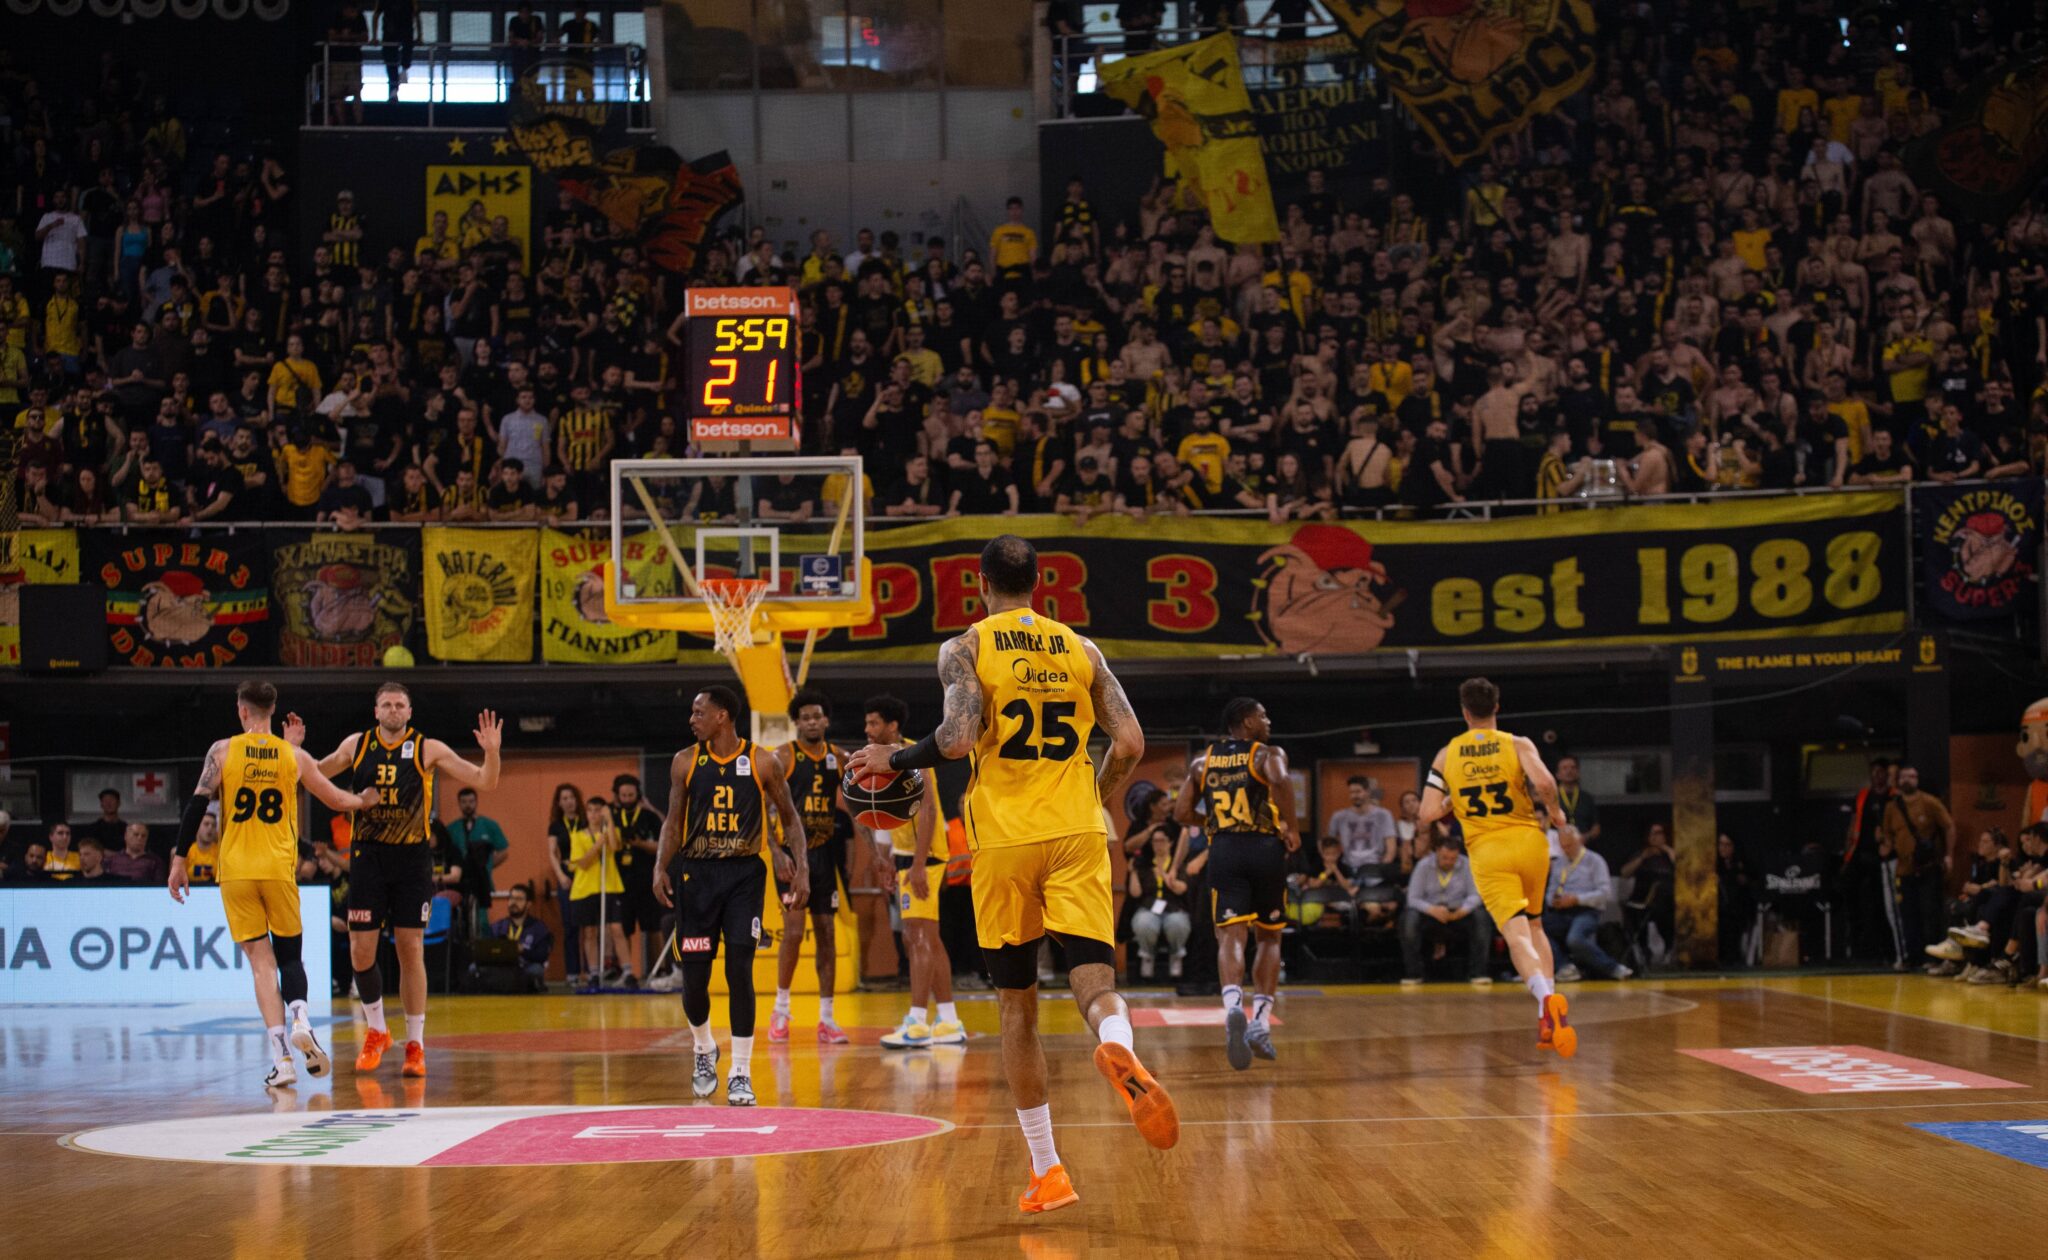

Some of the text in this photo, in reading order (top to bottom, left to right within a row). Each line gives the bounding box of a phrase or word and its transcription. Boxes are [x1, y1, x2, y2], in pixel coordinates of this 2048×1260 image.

[694, 294, 776, 309] betsson
[716, 319, 788, 351] 5:59
[695, 421, 779, 436] betsson
[551, 542, 645, 567] SUPR
[1145, 553, 1219, 635] 3
[1431, 555, 1585, 637] est
[1637, 530, 1884, 624] 1988
[1049, 635, 1070, 655] JR.
[1716, 648, 1902, 670] THE FLAME IN YOUR HEART
[1017, 661, 1068, 683] Midea
[999, 699, 1079, 761] 25
[1208, 752, 1251, 769] BARTLEY
[375, 764, 398, 785] 33
[812, 774, 824, 794] 2
[232, 787, 283, 824] 98
[380, 788, 399, 806] EK
[713, 784, 734, 809] 21
[803, 795, 830, 813] AEK
[1459, 781, 1514, 817] 33
[1212, 786, 1254, 829] 24
[706, 812, 741, 832] AEK
[348, 910, 371, 921] AVIS
[682, 936, 711, 951] AVIS
